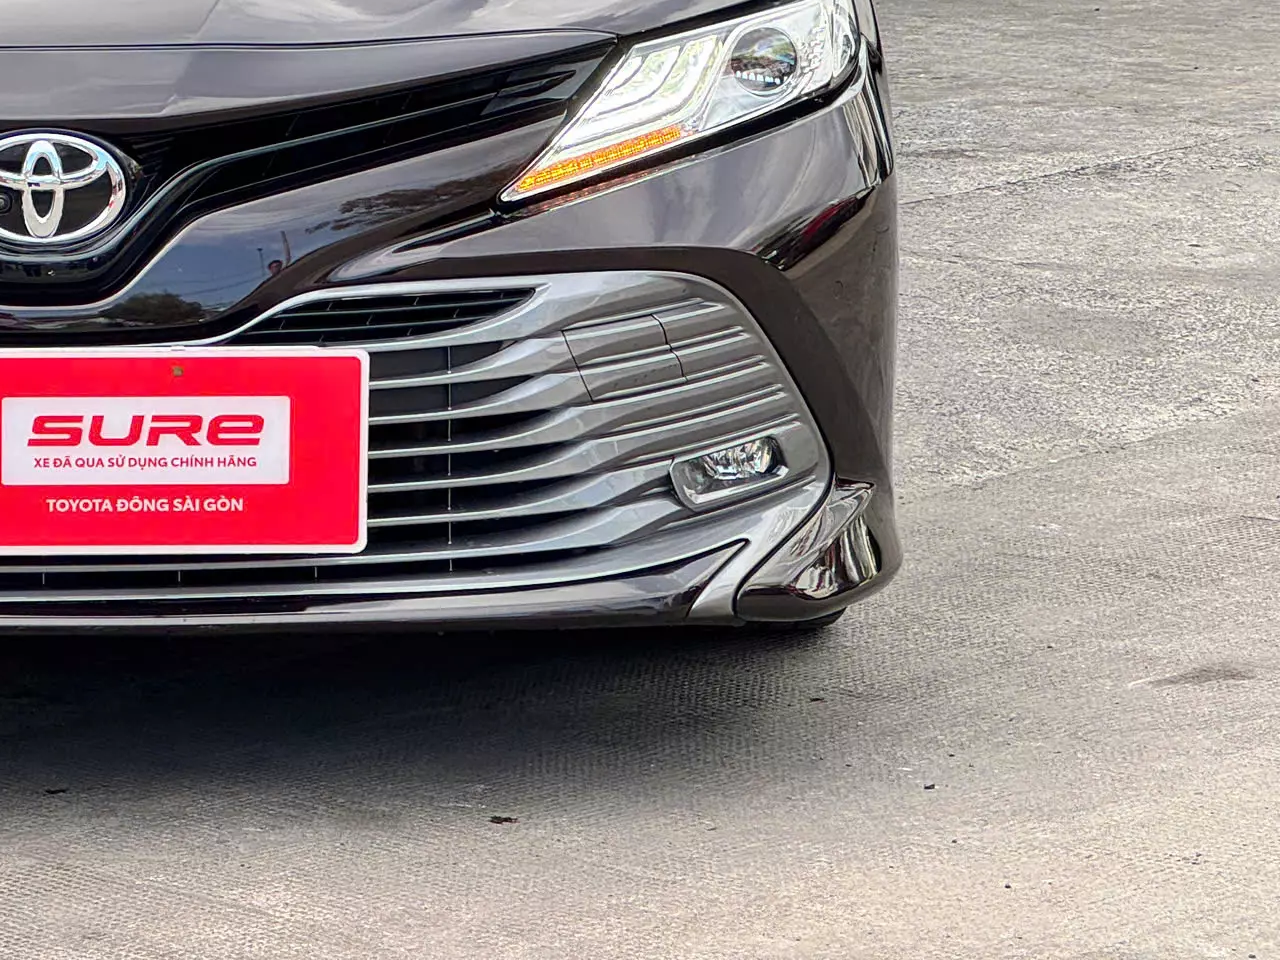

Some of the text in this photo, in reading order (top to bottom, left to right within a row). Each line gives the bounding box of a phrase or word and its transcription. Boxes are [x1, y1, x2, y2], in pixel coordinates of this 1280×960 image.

[34, 454, 257, 471] XE ĐÃ QUA SỬ DỤNG CHÍNH HÃNG
[46, 494, 244, 513] TOYOTA ĐÔNG SÀI GÒN
